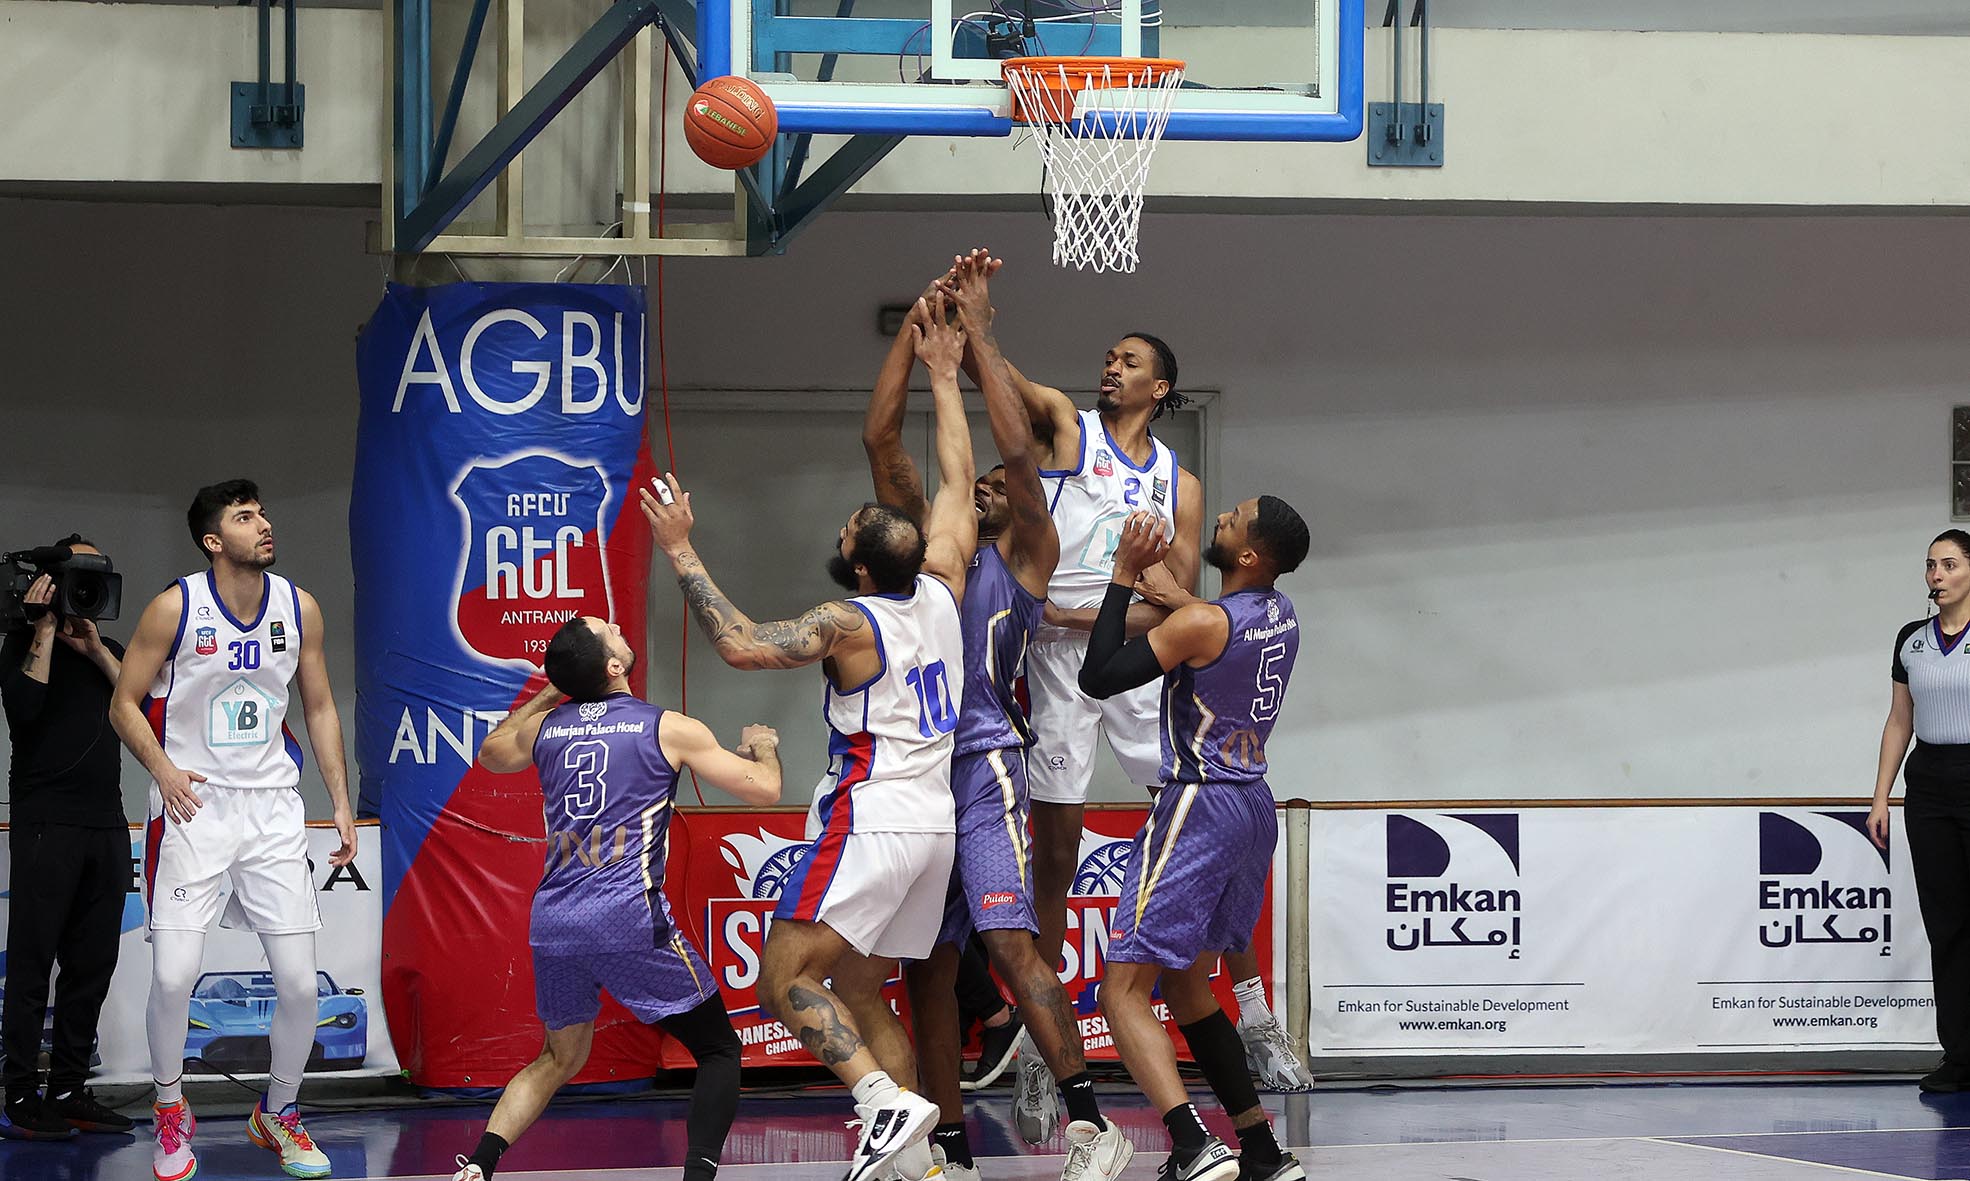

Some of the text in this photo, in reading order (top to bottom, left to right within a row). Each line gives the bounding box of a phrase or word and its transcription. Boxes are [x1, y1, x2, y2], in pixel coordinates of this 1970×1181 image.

[707, 110, 748, 137] LEBANESE
[392, 306, 646, 416] AGBU
[1124, 477, 1140, 506] 2
[228, 640, 260, 670] 30
[524, 640, 551, 652] 193
[1250, 643, 1286, 723] 5
[905, 658, 960, 738] 10
[221, 701, 258, 730] YB
[543, 721, 644, 740] Al Murjan Palace Hotel
[564, 739, 609, 820] 3
[1387, 883, 1520, 912] Emkan
[1759, 881, 1891, 909] Emkan
[1387, 917, 1520, 959] إمكان
[1760, 914, 1891, 956] إمكان
[1338, 999, 1569, 1013] Emkan for Sustainable Development
[1712, 997, 1754, 1009] Emkan
[1758, 997, 1775, 1009] for
[1779, 996, 1851, 1009] Sustainable
[1400, 1019, 1506, 1032] www.emkan.org
[1773, 1015, 1878, 1028] www.emkan.org
